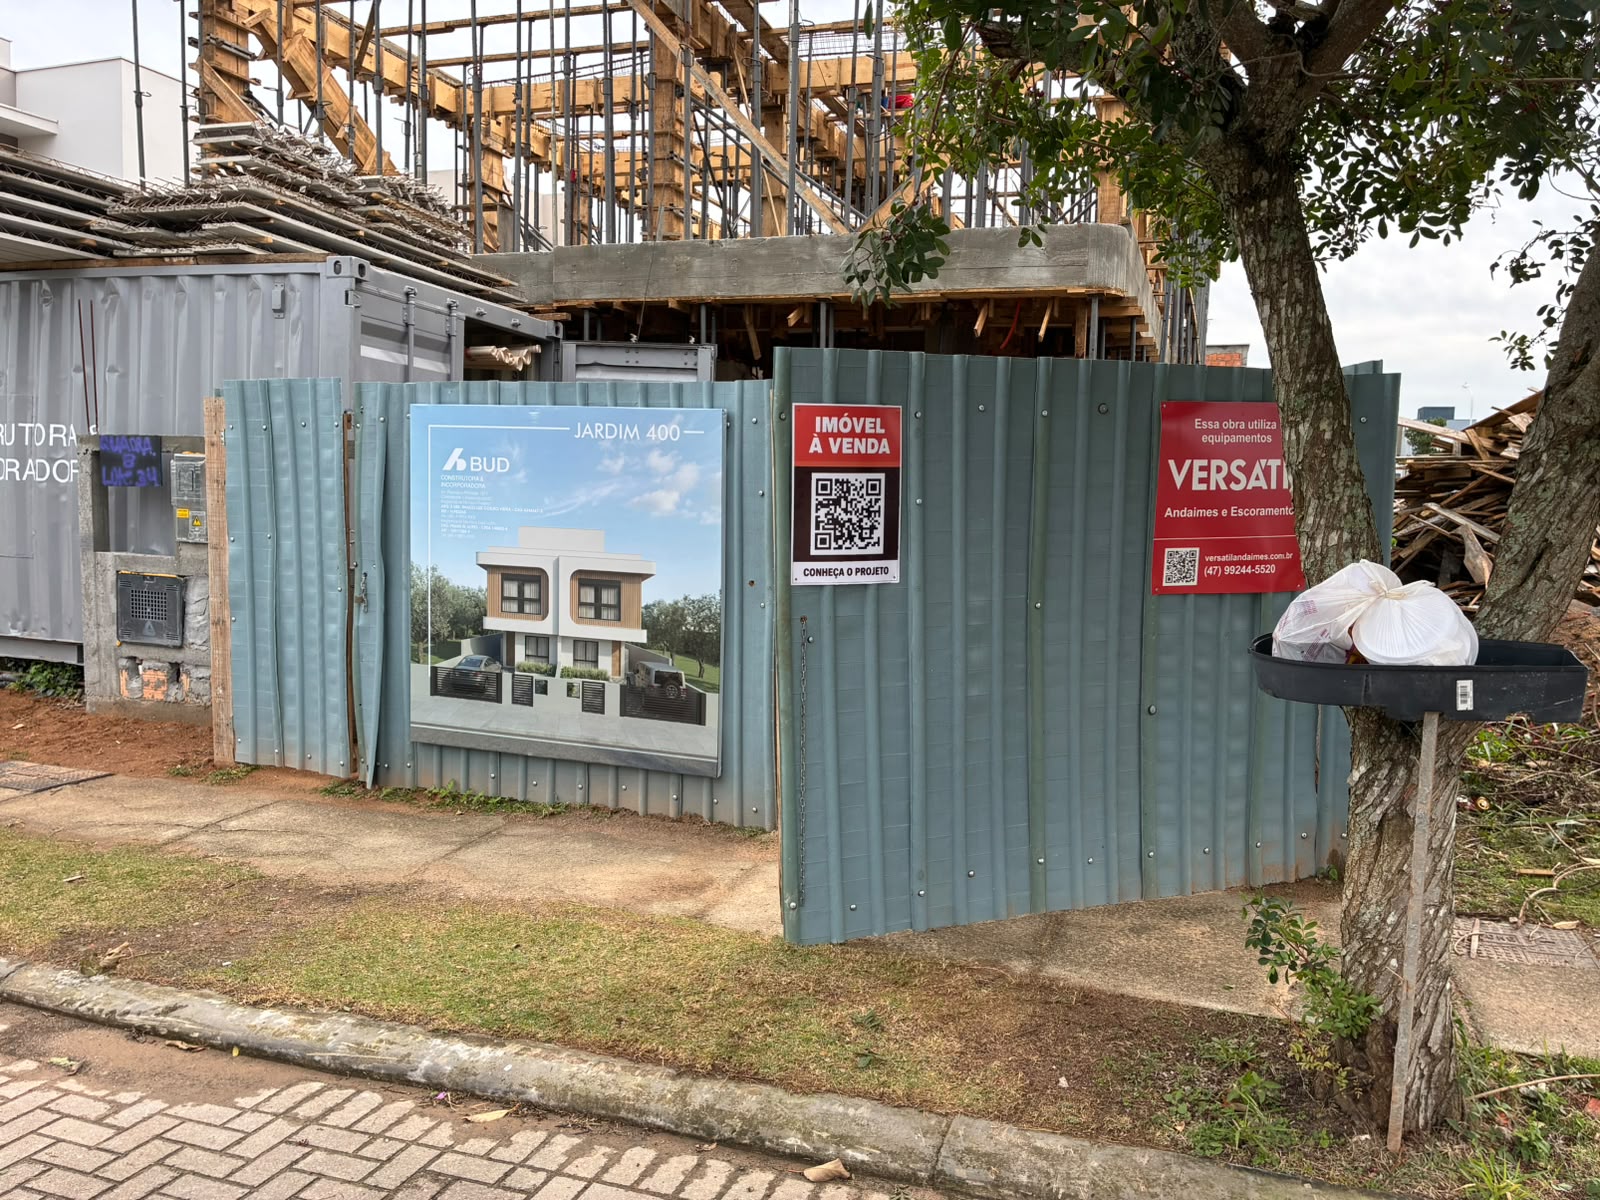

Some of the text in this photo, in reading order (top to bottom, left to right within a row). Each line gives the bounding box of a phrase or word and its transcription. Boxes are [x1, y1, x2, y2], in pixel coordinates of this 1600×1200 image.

[815, 413, 886, 434] IMÓVEL
[1194, 419, 1277, 429] Essa obra utiliza
[574, 422, 681, 441] JARDIM 400
[808, 433, 891, 454] À VENDA
[1201, 432, 1272, 445] equipamentos
[470, 456, 511, 473] BUD
[1164, 507, 1219, 518] Andaimes
[1221, 509, 1228, 517] e
[1205, 552, 1293, 562] versatilandaimes.com.br
[803, 566, 889, 578] CONHEÇA O PROJETO
[1204, 564, 1276, 577] (47) 99244-5520
